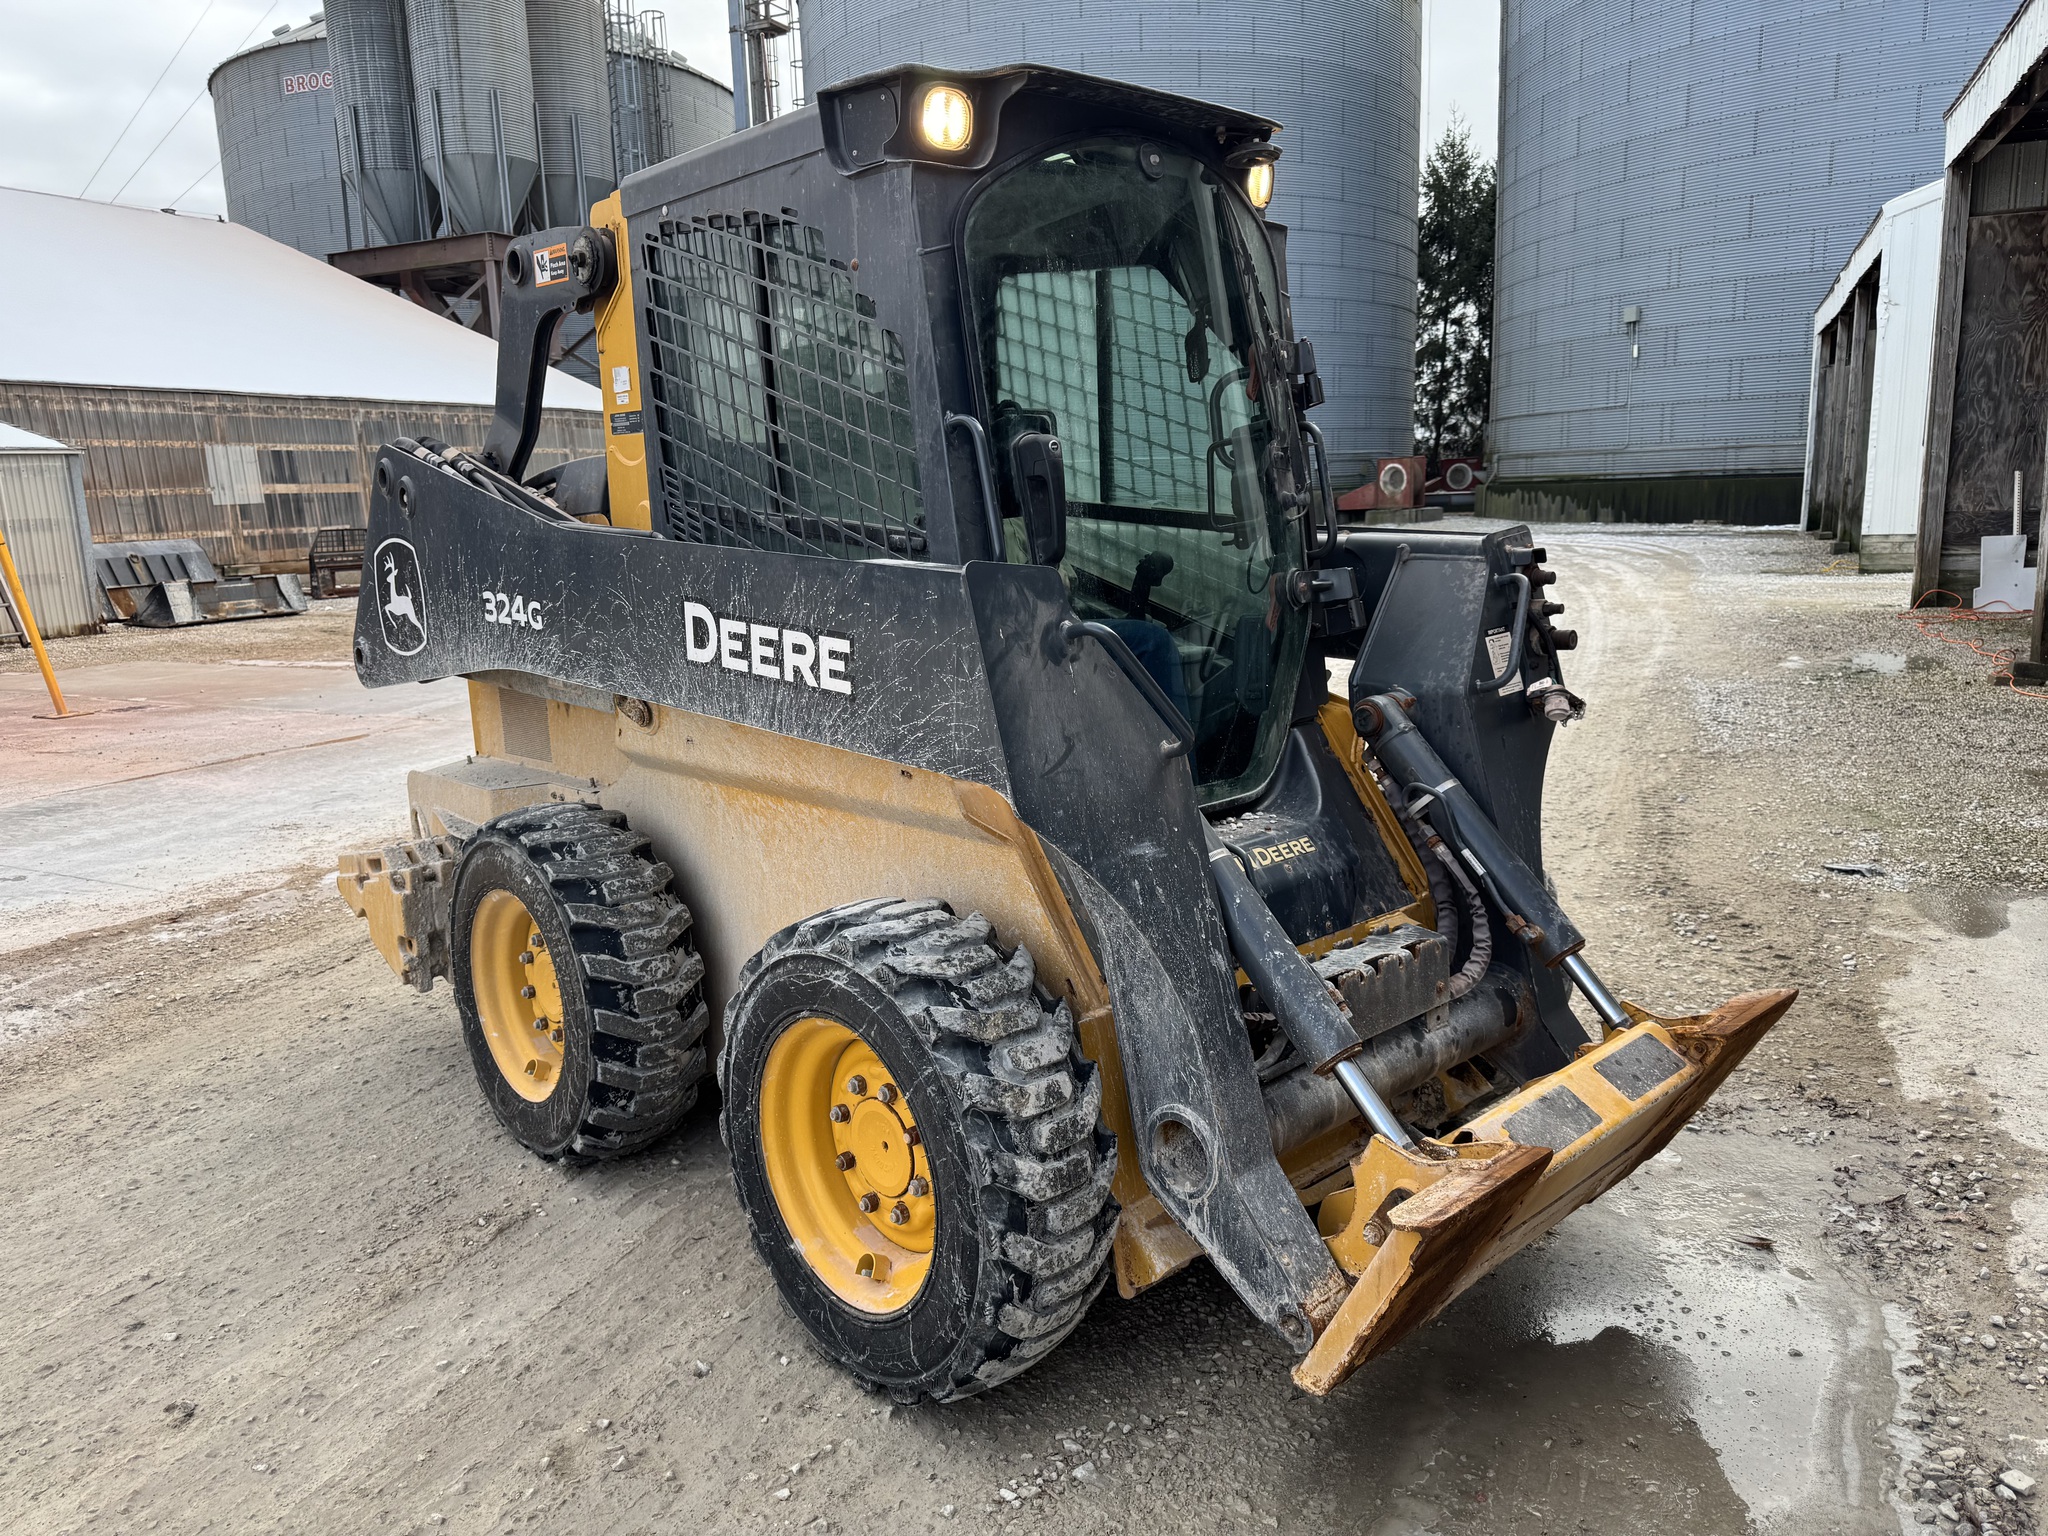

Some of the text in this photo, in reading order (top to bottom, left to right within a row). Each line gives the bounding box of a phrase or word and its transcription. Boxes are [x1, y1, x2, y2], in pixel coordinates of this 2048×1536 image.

[283, 71, 333, 94] BROC
[482, 590, 543, 631] 324G
[683, 600, 852, 695] DEERE
[1252, 837, 1316, 866] DEERE
